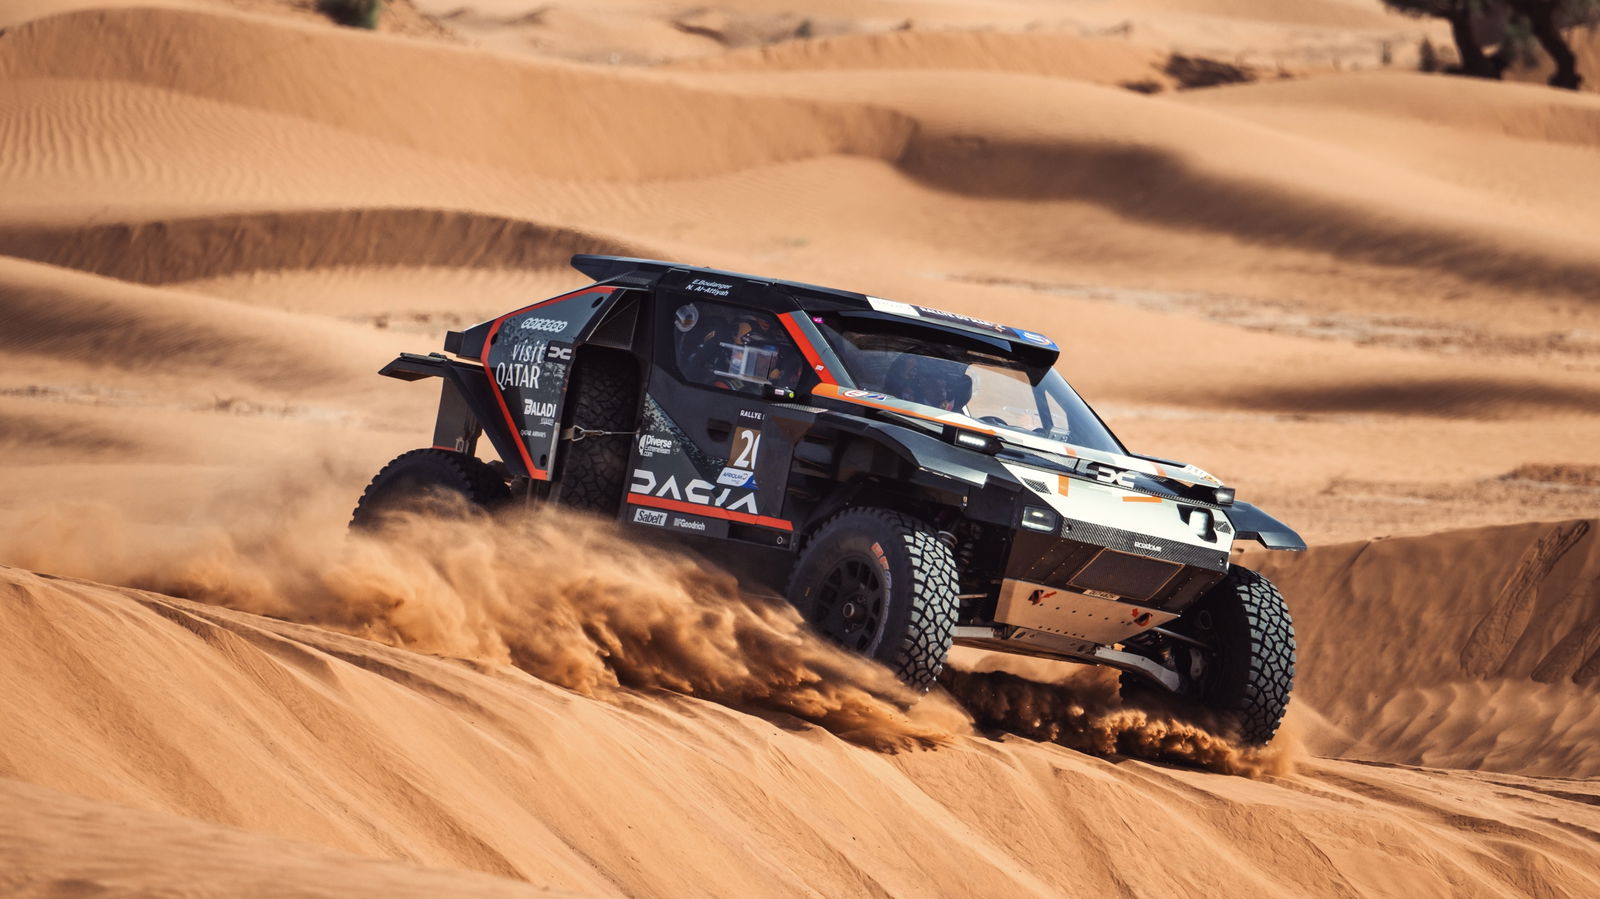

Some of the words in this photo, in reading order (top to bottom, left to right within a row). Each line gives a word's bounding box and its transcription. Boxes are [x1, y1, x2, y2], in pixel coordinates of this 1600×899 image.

[521, 317, 568, 332] ooredoo
[512, 339, 547, 363] visit
[496, 362, 541, 390] QATAR
[524, 398, 557, 418] BALADI
[740, 410, 761, 420] RALLYE
[646, 434, 672, 449] Diverse
[630, 468, 758, 514] DACIA
[637, 510, 664, 525] Sabelt
